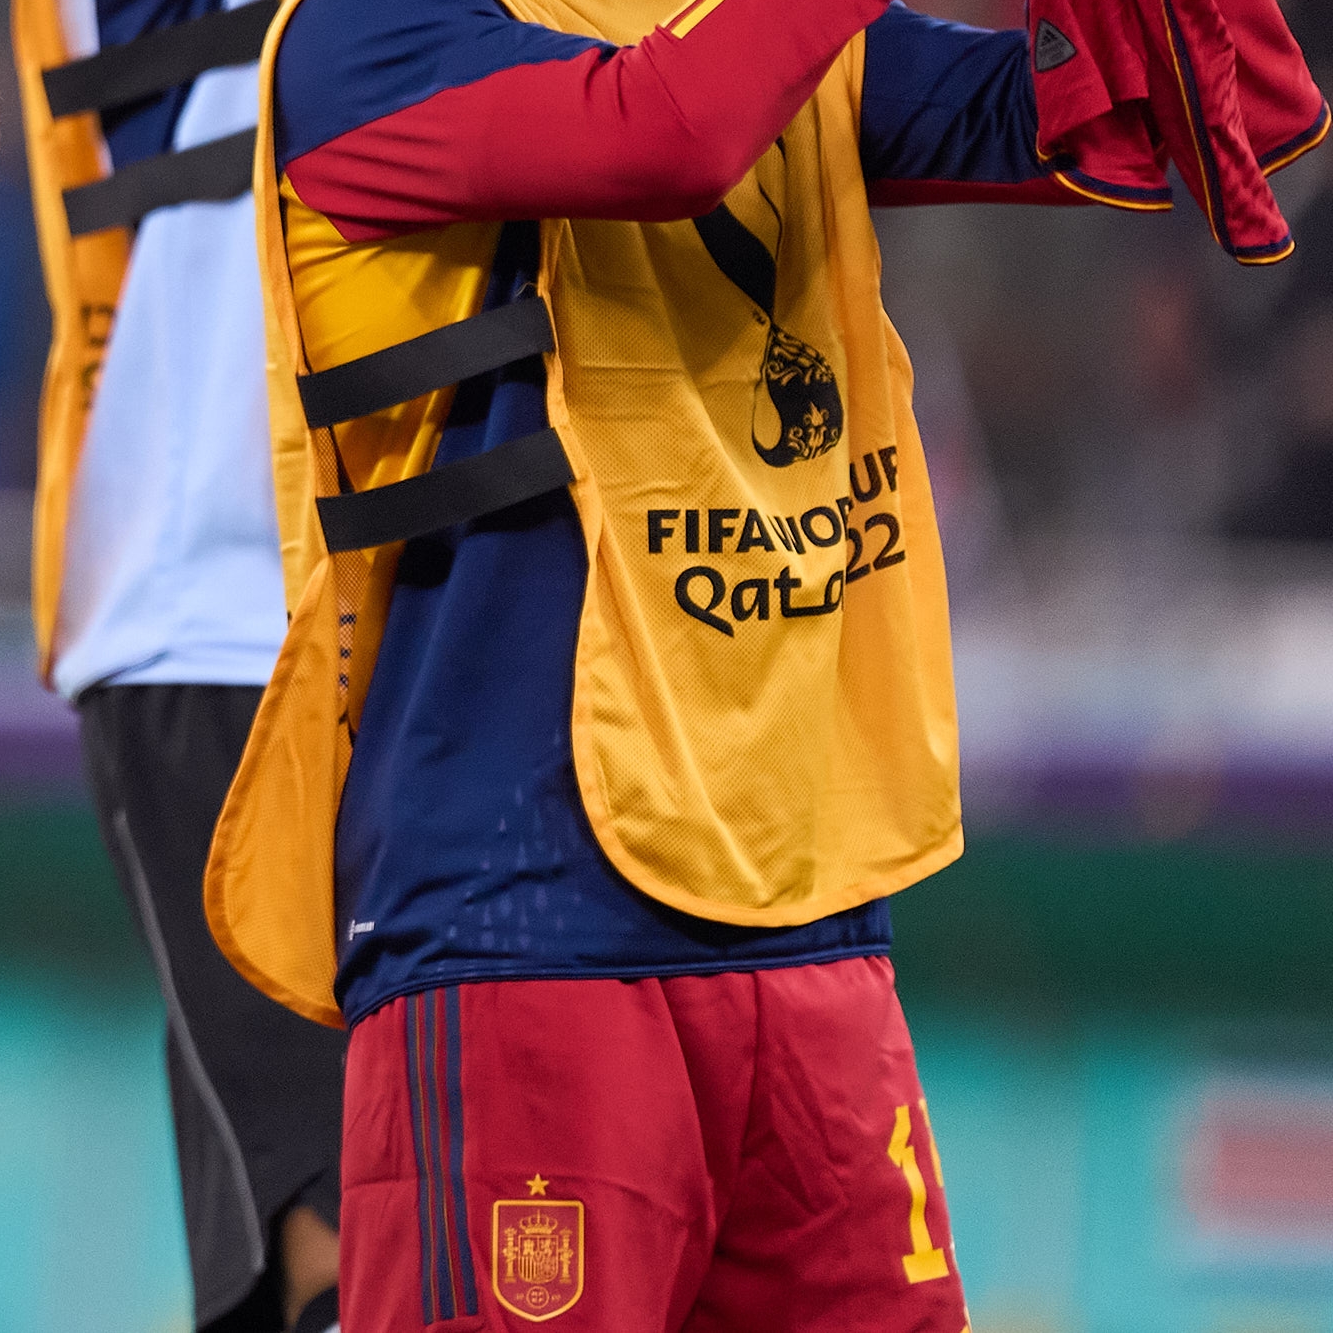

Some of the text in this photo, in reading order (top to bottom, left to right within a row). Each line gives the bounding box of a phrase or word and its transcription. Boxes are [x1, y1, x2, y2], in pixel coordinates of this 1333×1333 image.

[647, 509, 776, 554] FIFA
[849, 445, 898, 505] UP
[675, 566, 845, 638] Qata
